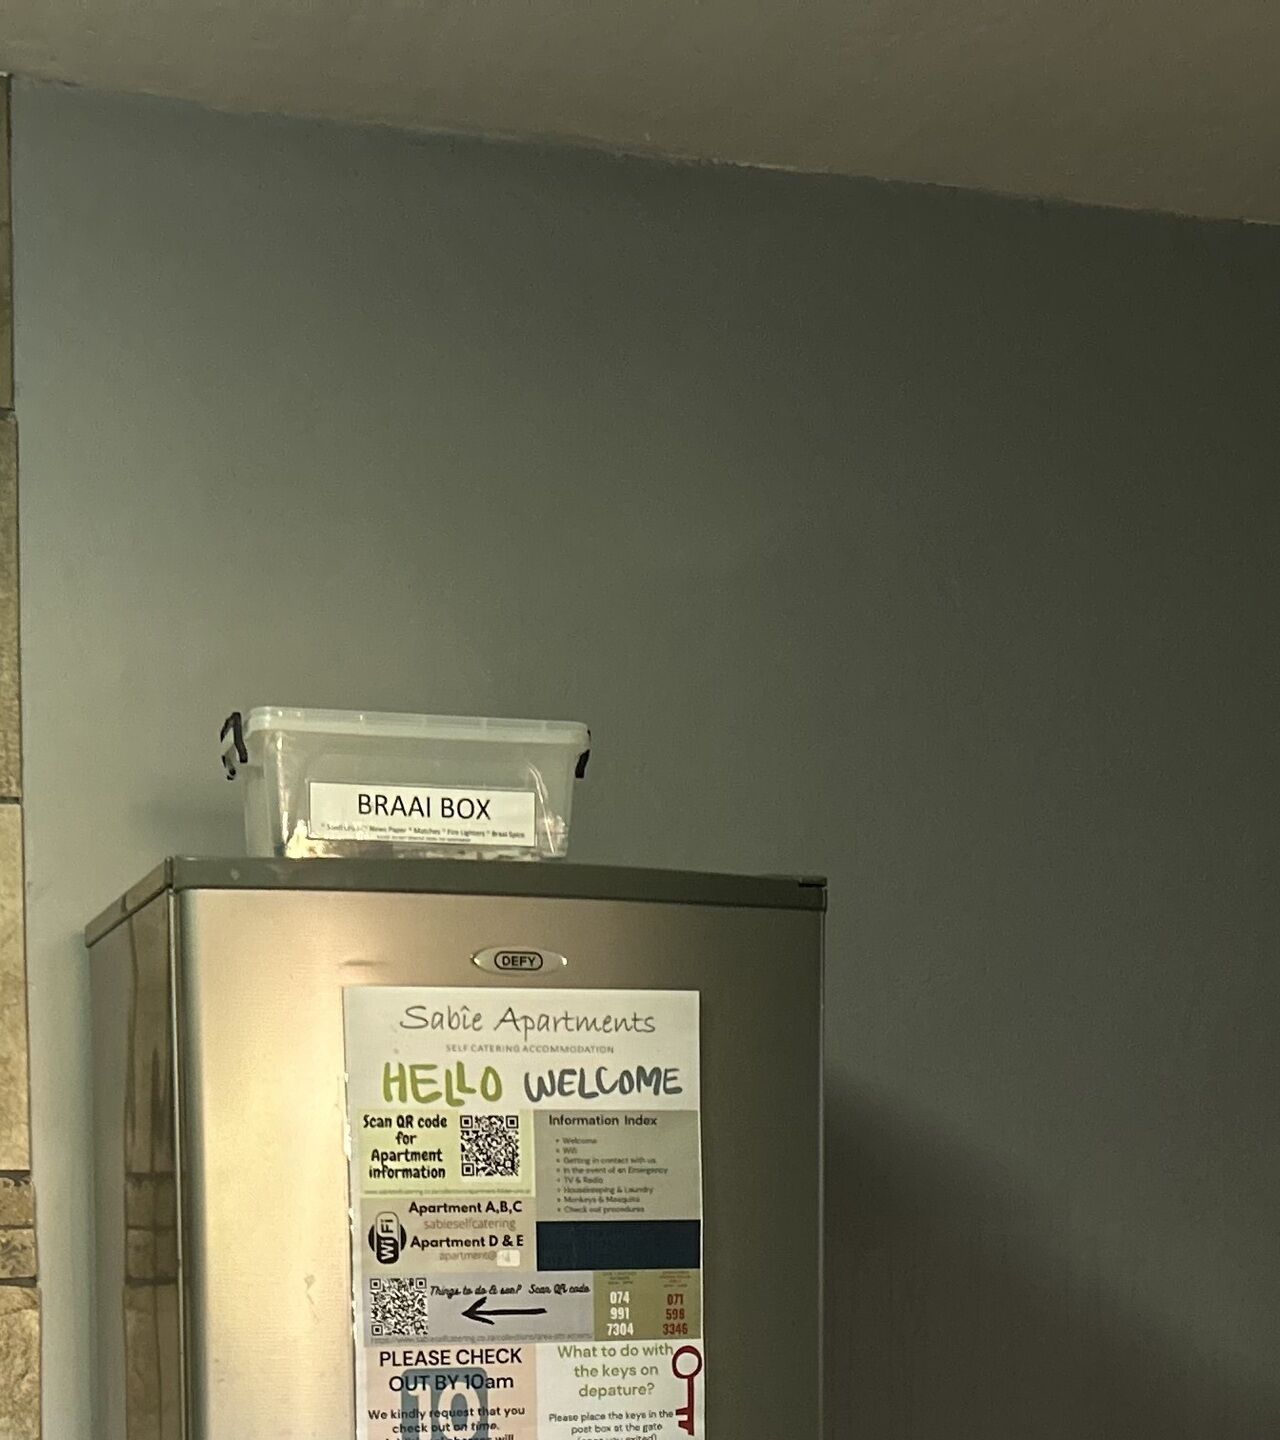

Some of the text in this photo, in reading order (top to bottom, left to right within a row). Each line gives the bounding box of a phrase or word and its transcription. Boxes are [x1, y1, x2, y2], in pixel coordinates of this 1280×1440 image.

[358, 794, 491, 820] BRAAI BOX
[501, 955, 536, 967] DEFY
[493, 1006, 656, 1042] Apartments
[446, 1044, 614, 1054] SELF CATERING ACCOMMODATION
[383, 1061, 683, 1107] HELLO WELCOME
[363, 1114, 448, 1129] Scan QR code
[549, 1114, 657, 1126] Information Index
[395, 1131, 417, 1145] for
[371, 1148, 443, 1167] Apartment
[369, 1165, 446, 1179] information
[409, 1201, 523, 1216] Apartment A,B,C
[410, 1235, 524, 1250] Apartment D & E
[430, 1284, 461, 1300] Things
[463, 1284, 473, 1295] to
[474, 1284, 488, 1295] do
[489, 1284, 499, 1295] &
[528, 1283, 551, 1294] Scan
[553, 1283, 567, 1296] QR
[569, 1284, 591, 1294] code
[609, 1291, 630, 1304] 074
[667, 1293, 684, 1306] 071
[610, 1307, 630, 1320] 991
[607, 1322, 634, 1336] 7304
[379, 1348, 522, 1367] PLEASE CHECK
[558, 1342, 674, 1359] What to do with
[574, 1364, 659, 1379] the keys on
[389, 1373, 514, 1391] OUT BY 10am
[578, 1382, 655, 1400] depature?
[368, 1406, 525, 1422] We kindly request that you
[548, 1409, 674, 1423] Please place the keys in the
[392, 1422, 428, 1433] check
[431, 1423, 450, 1432] out
[571, 1422, 663, 1435] post box at the gate
